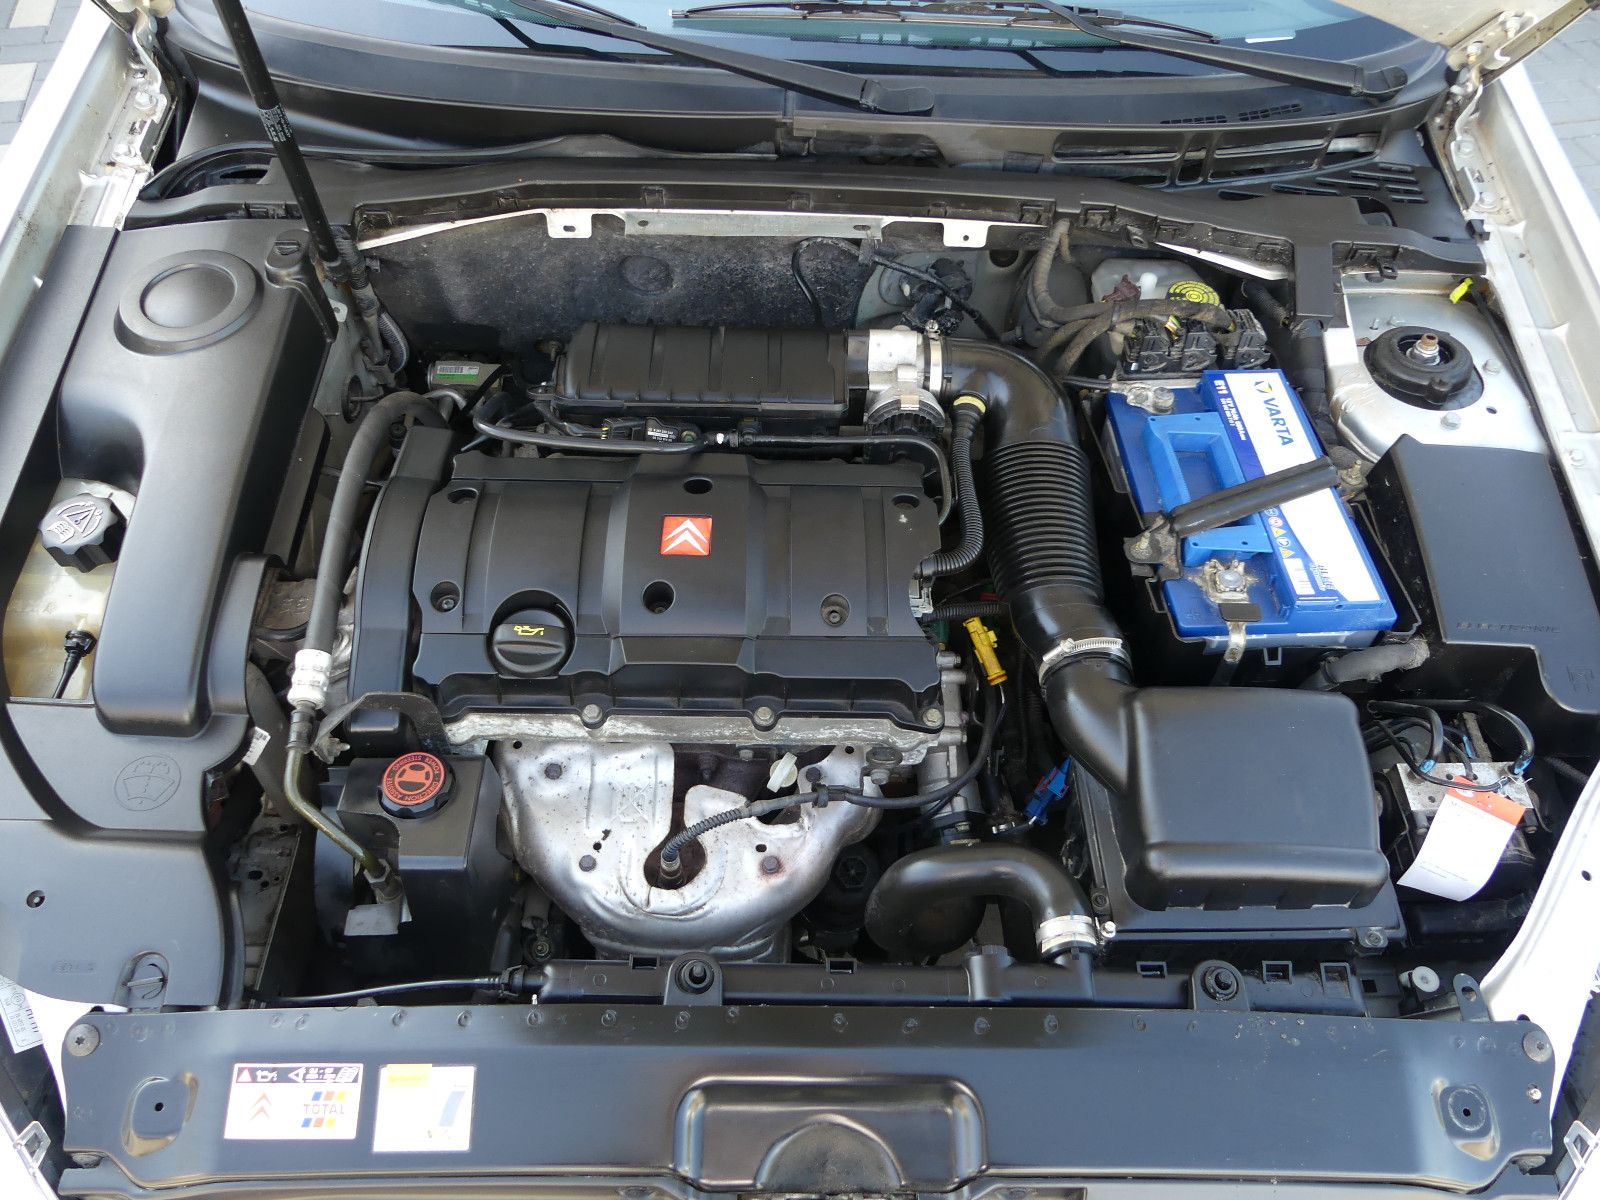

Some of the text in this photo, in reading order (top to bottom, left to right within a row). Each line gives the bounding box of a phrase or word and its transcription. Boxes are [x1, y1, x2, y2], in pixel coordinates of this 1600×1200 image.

[1213, 379, 1228, 395] E11
[1263, 397, 1294, 446] VARTA
[404, 781, 438, 801] DIRECTION
[303, 1103, 345, 1115] TOTAL
